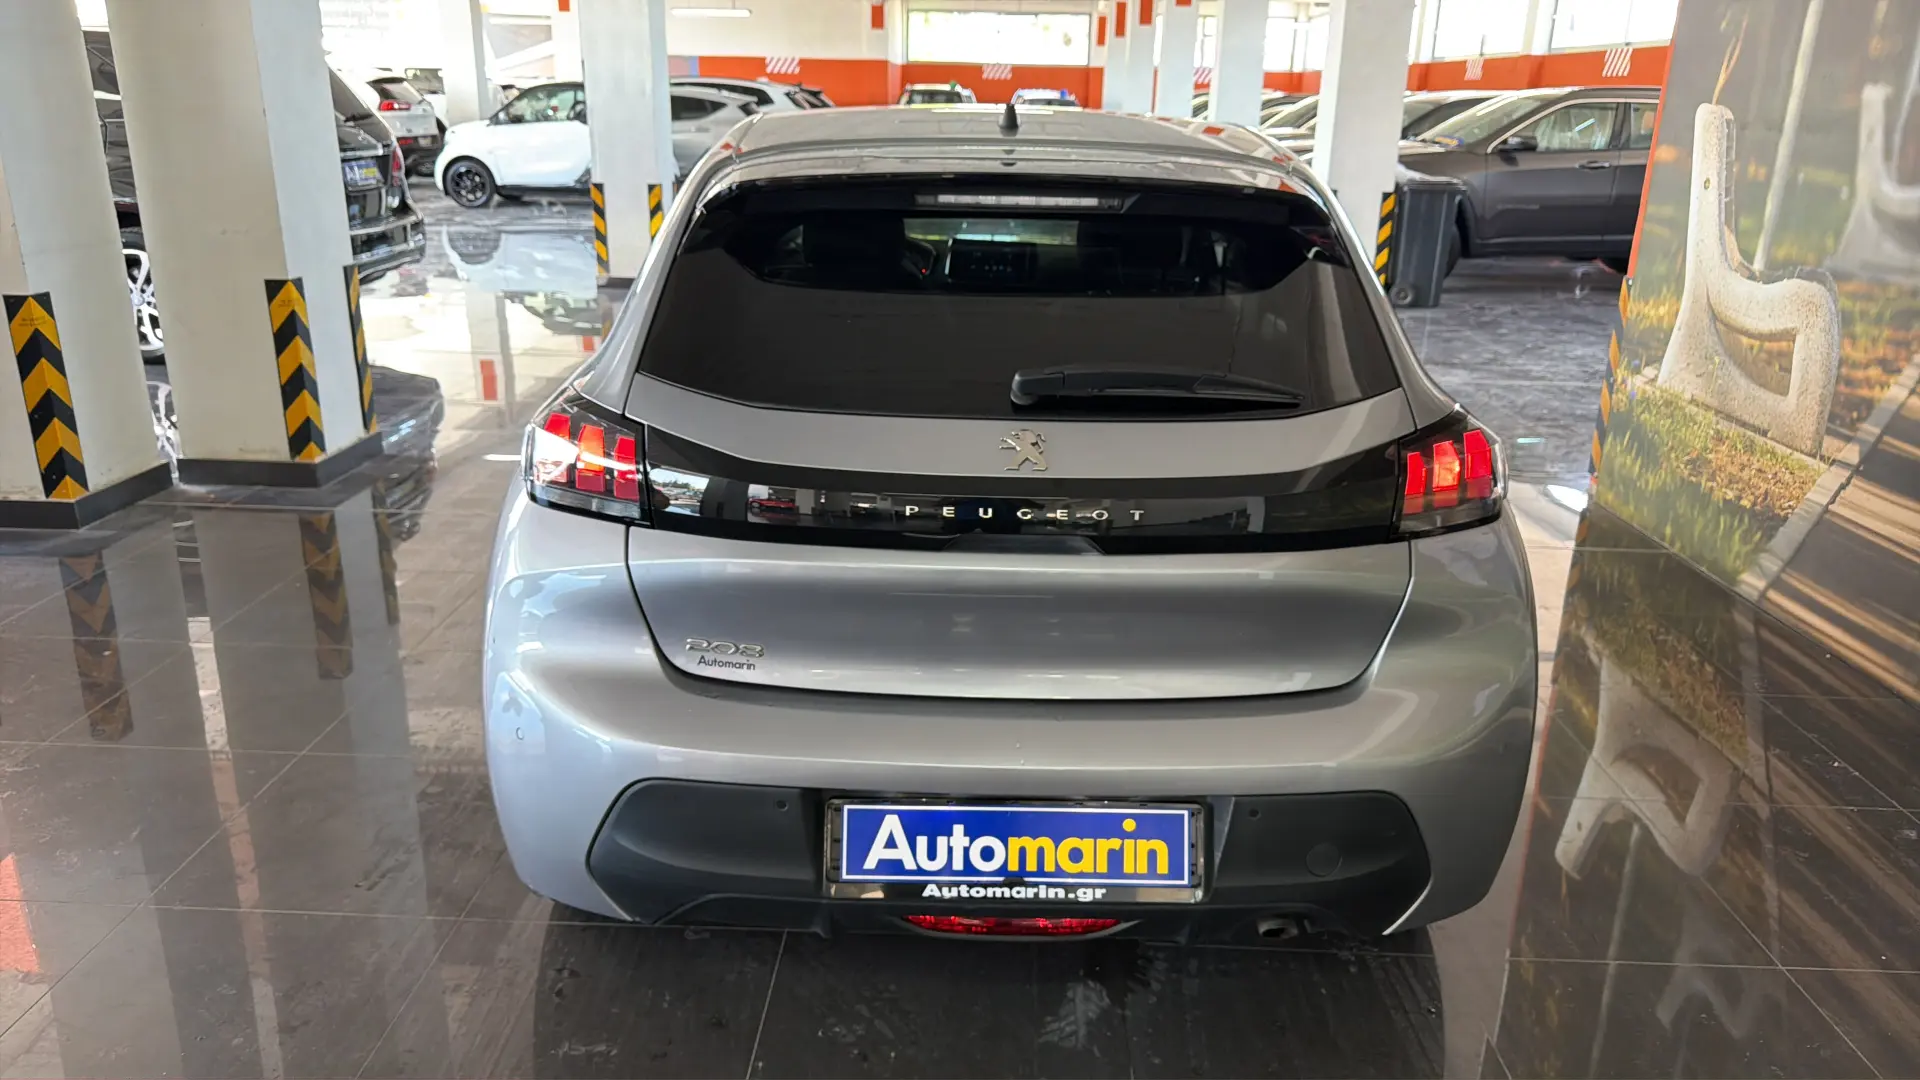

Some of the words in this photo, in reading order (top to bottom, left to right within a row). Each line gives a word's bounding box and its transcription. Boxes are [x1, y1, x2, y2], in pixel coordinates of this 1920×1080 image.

[905, 505, 1145, 521] PEUGEOT
[685, 638, 765, 658] 208
[697, 654, 756, 671] Automarin
[863, 813, 1169, 875] Automarin
[921, 883, 1107, 902] Automarin.gr
